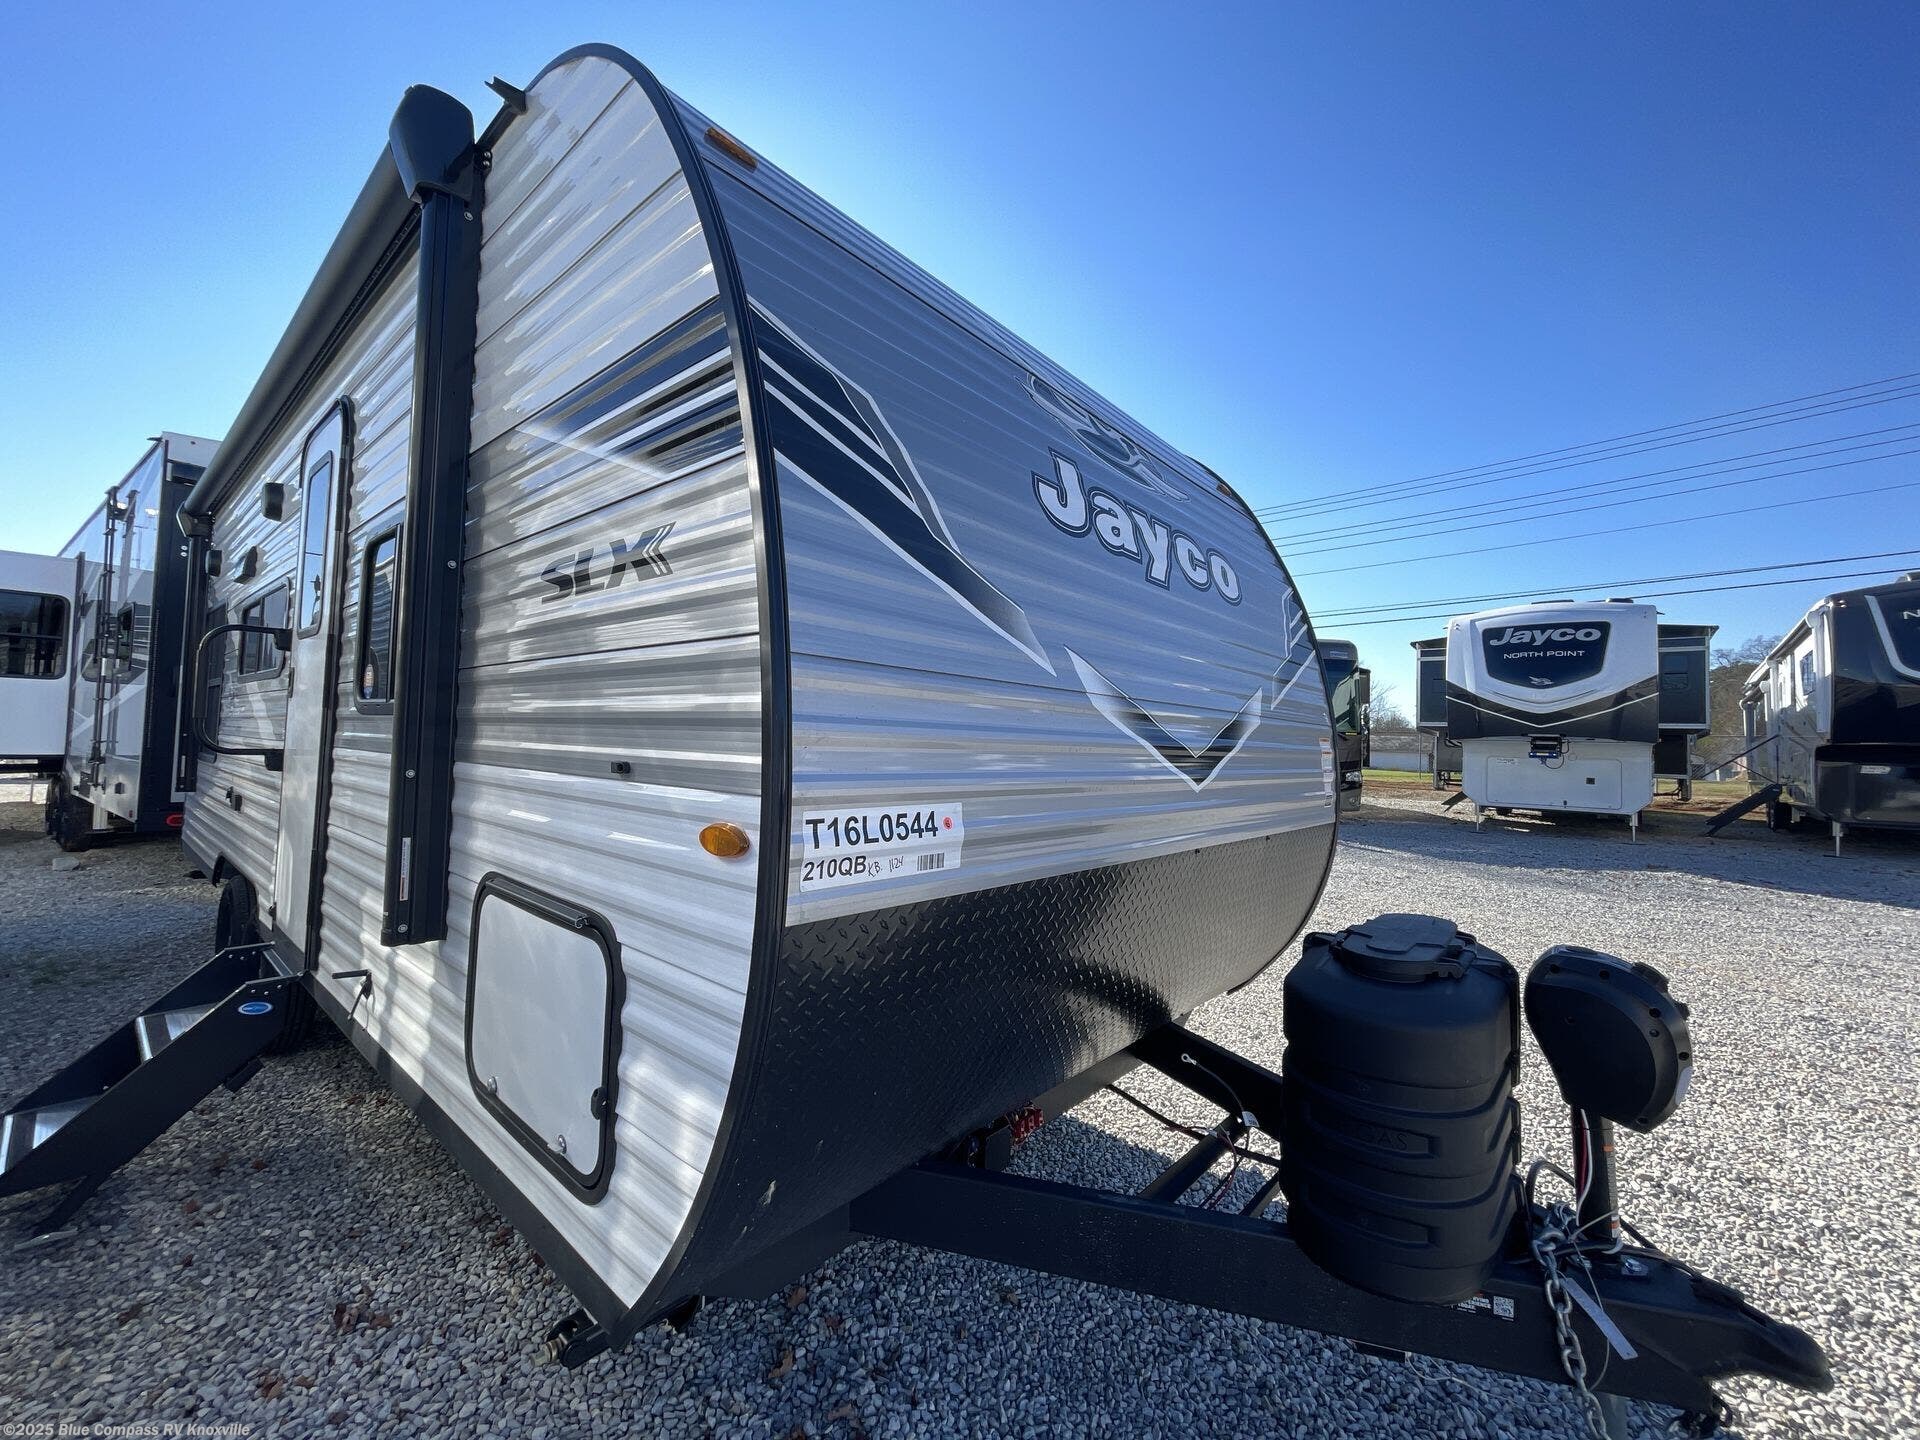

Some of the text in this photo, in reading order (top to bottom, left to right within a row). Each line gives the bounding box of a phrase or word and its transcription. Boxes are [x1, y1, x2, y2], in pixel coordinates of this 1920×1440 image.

[1032, 447, 1242, 606] Jayco
[541, 521, 677, 605] SLX
[1490, 627, 1601, 646] Jayco
[1503, 651, 1543, 660] NORTH
[806, 812, 938, 849] T16L0544
[803, 856, 865, 881] 210QB
